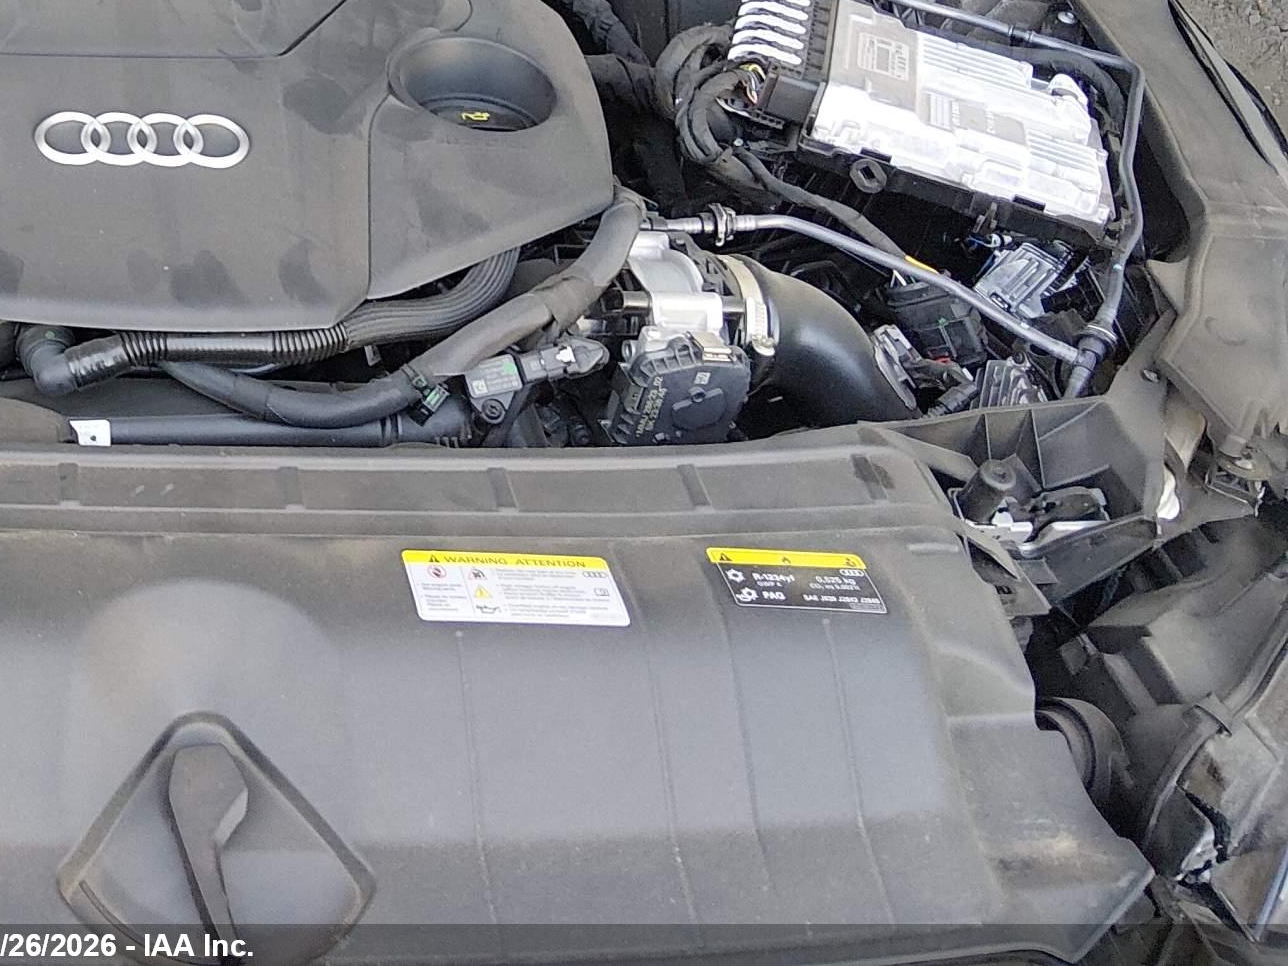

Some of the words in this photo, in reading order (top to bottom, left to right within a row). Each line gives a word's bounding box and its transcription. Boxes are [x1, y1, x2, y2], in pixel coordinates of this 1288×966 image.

[443, 555, 508, 566] WARNING
[515, 559, 586, 568] ATTENTION
[751, 572, 795, 583] R-1234yf
[761, 590, 786, 600] PAG
